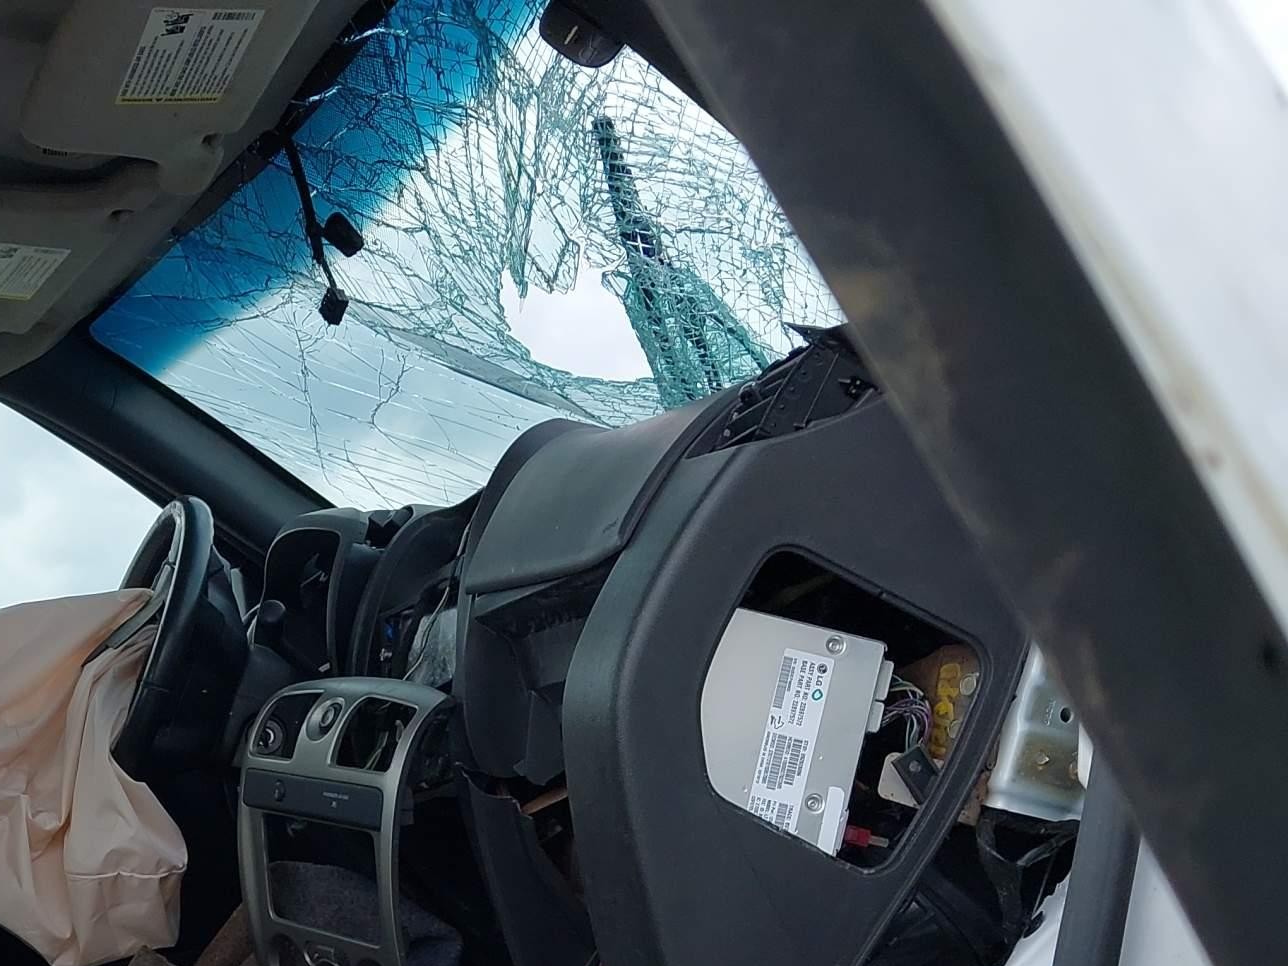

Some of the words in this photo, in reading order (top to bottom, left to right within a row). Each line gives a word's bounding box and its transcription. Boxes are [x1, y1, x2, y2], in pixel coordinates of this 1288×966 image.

[796, 674, 804, 688] PART
[804, 676, 812, 690] PART
[815, 675, 823, 686] LG
